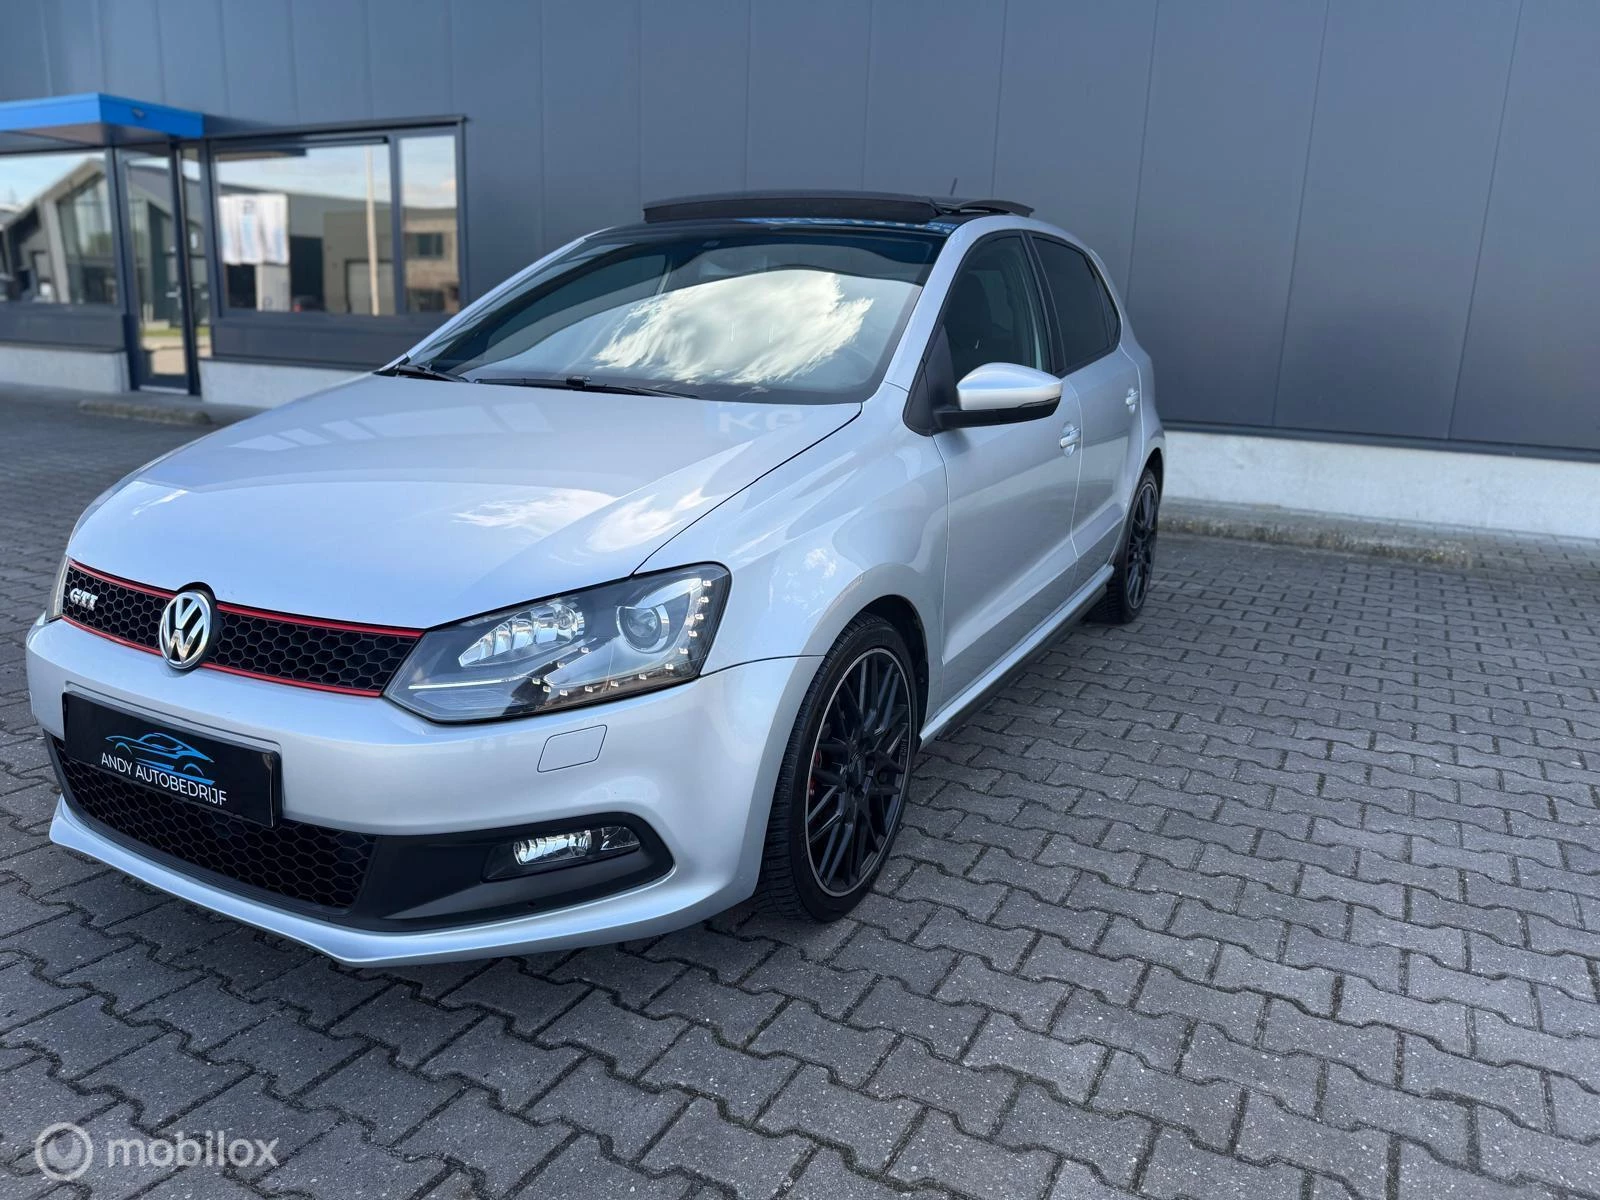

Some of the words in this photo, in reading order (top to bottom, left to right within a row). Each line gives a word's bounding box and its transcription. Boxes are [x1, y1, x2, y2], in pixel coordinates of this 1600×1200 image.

[70, 588, 98, 611] GTI
[101, 752, 132, 775] ANDY
[135, 765, 227, 805] AUTOBEDRIJF
